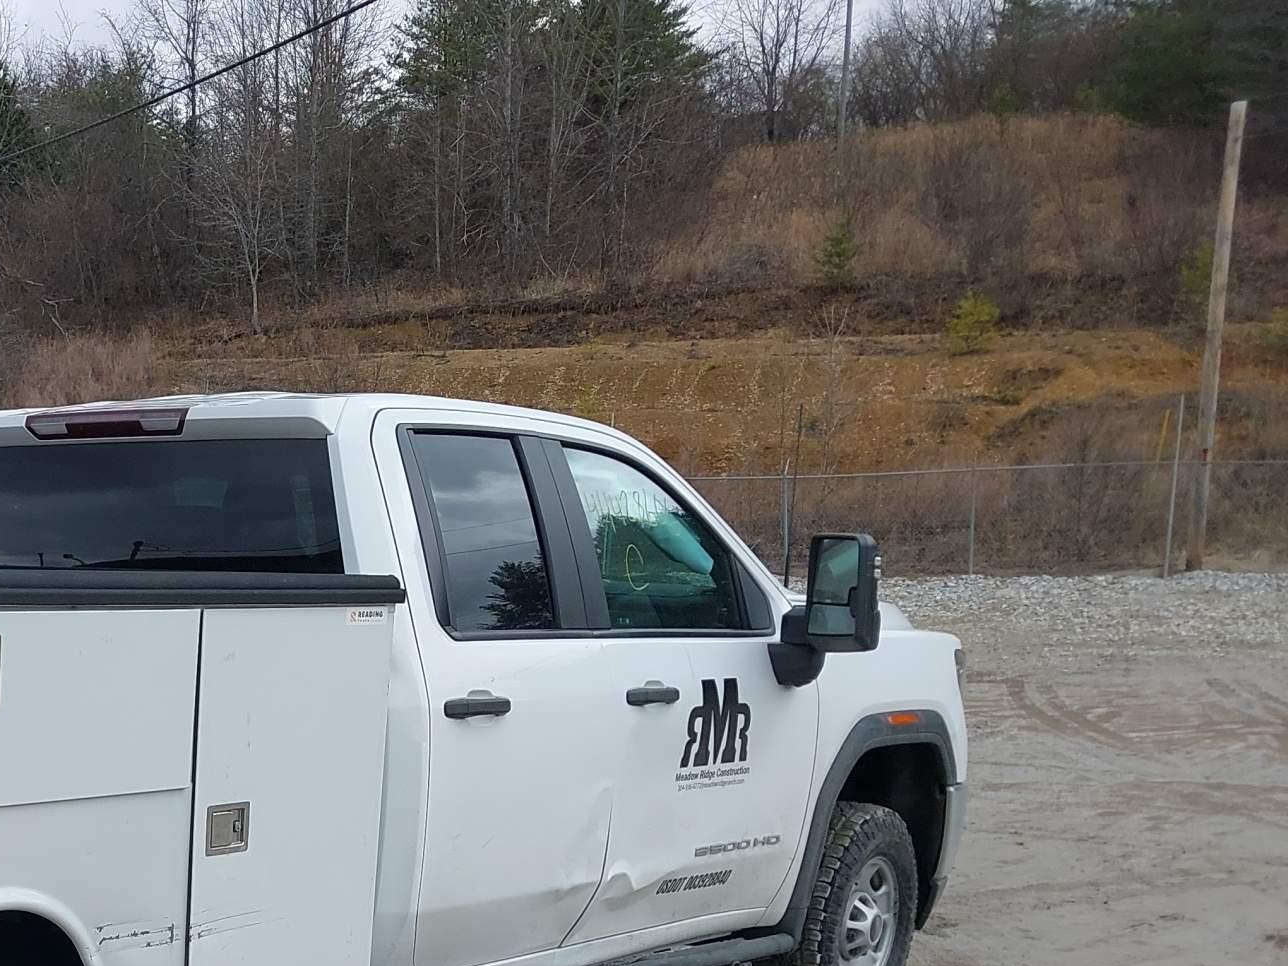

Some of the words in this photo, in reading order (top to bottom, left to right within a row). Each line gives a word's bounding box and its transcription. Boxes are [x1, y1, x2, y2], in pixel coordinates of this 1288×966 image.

[358, 610, 384, 618] READING
[675, 771, 699, 782] Meadow
[699, 768, 716, 781] Ridge
[716, 766, 751, 778] Construction
[753, 835, 781, 848] HD
[655, 876, 688, 895] USDOT
